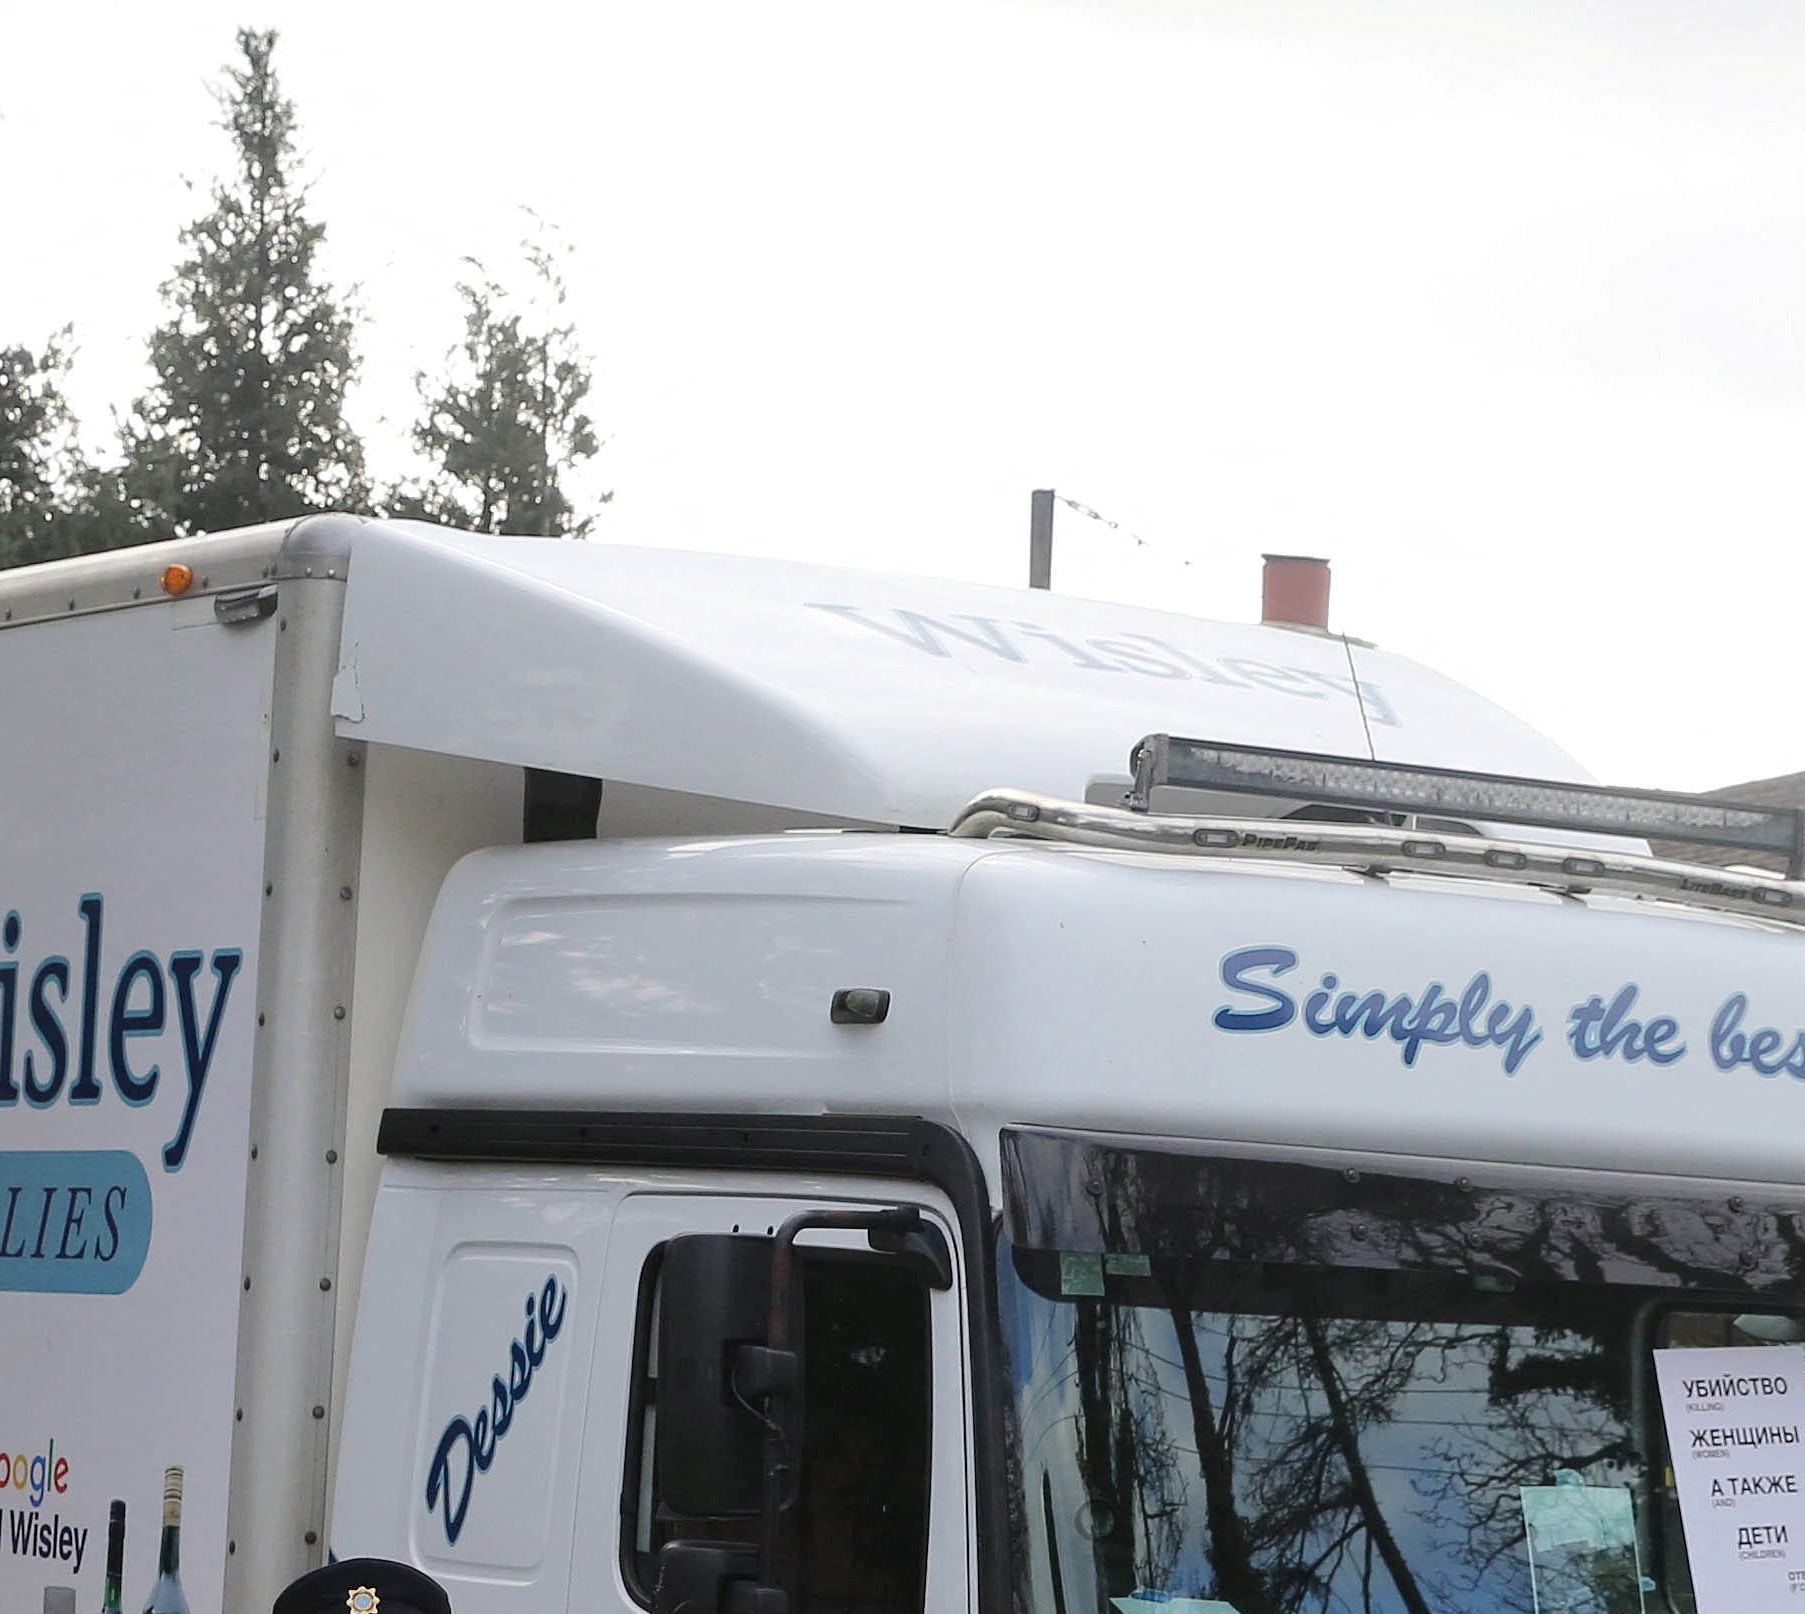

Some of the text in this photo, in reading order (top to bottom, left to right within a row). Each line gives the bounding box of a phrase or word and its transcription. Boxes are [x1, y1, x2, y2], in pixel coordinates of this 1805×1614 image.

[1211, 944, 1543, 1075] Simply
[1566, 980, 1687, 1066] the
[1683, 1374, 1788, 1398] УБИЙСТВО
[426, 1273, 566, 1547] Dessie
[1690, 1425, 1800, 1449] ЖЕНЩИНЫ
[1711, 1475, 1798, 1497] А ТАКЖЕ
[9, 1510, 88, 1574] Wisley
[1738, 1525, 1789, 1549] ДЕТИ
